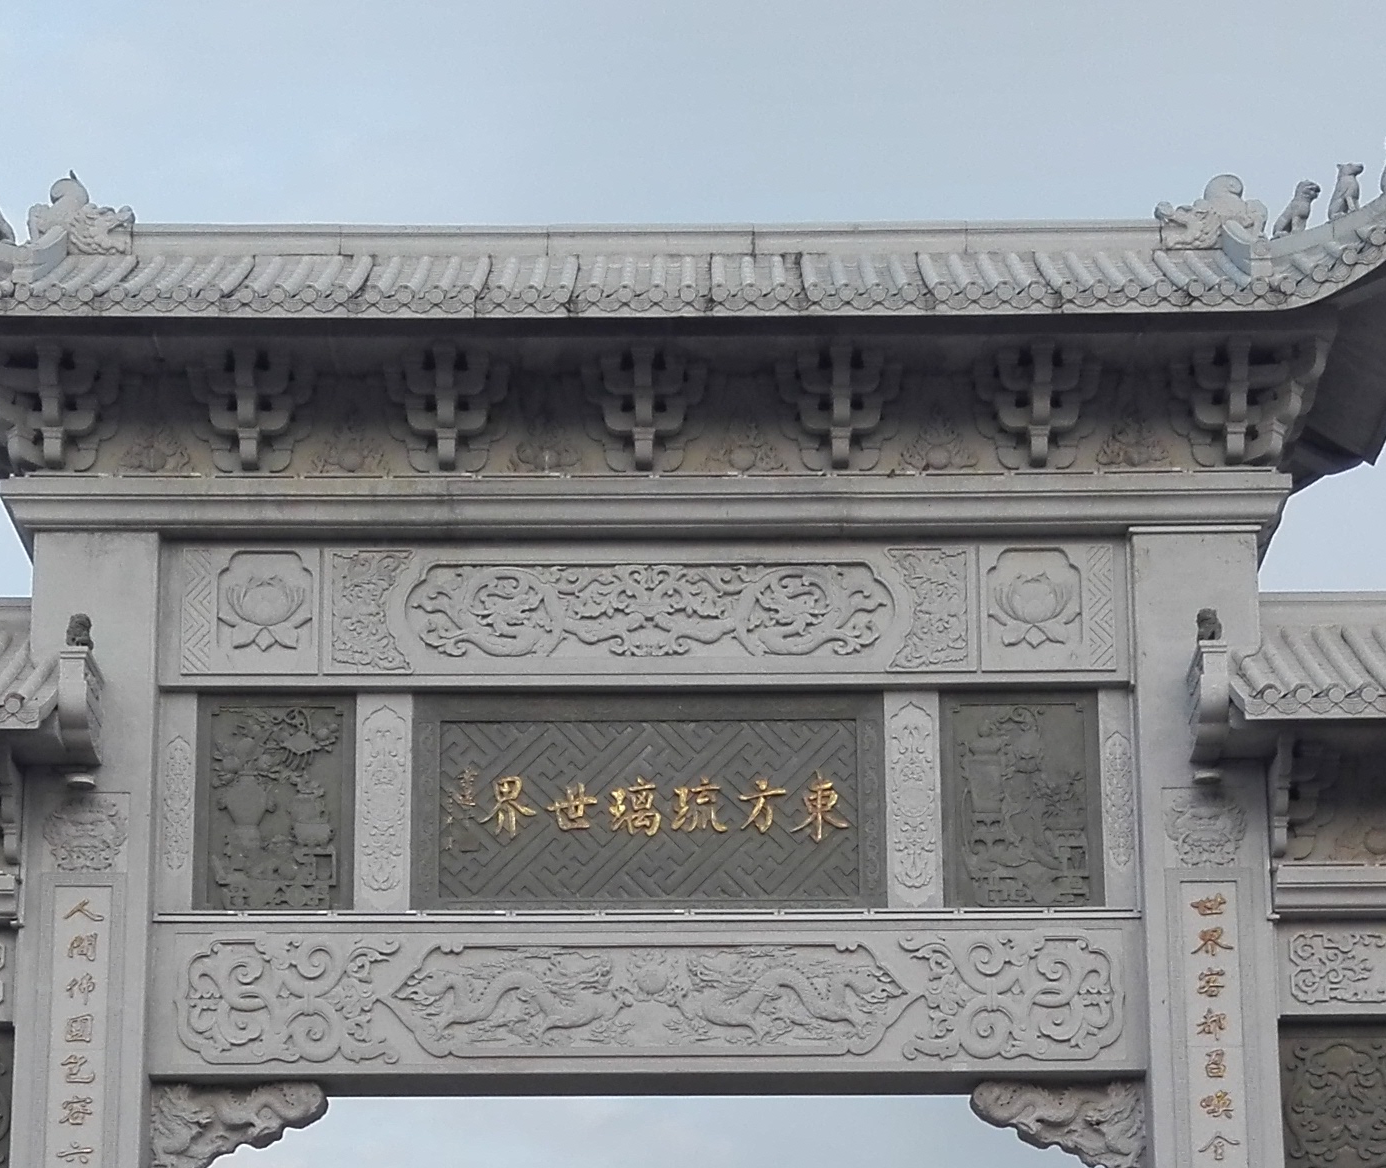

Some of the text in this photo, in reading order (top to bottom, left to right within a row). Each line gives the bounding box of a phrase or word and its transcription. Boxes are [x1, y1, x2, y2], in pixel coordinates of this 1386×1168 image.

[480, 769, 850, 844] 東方琉璃世界
